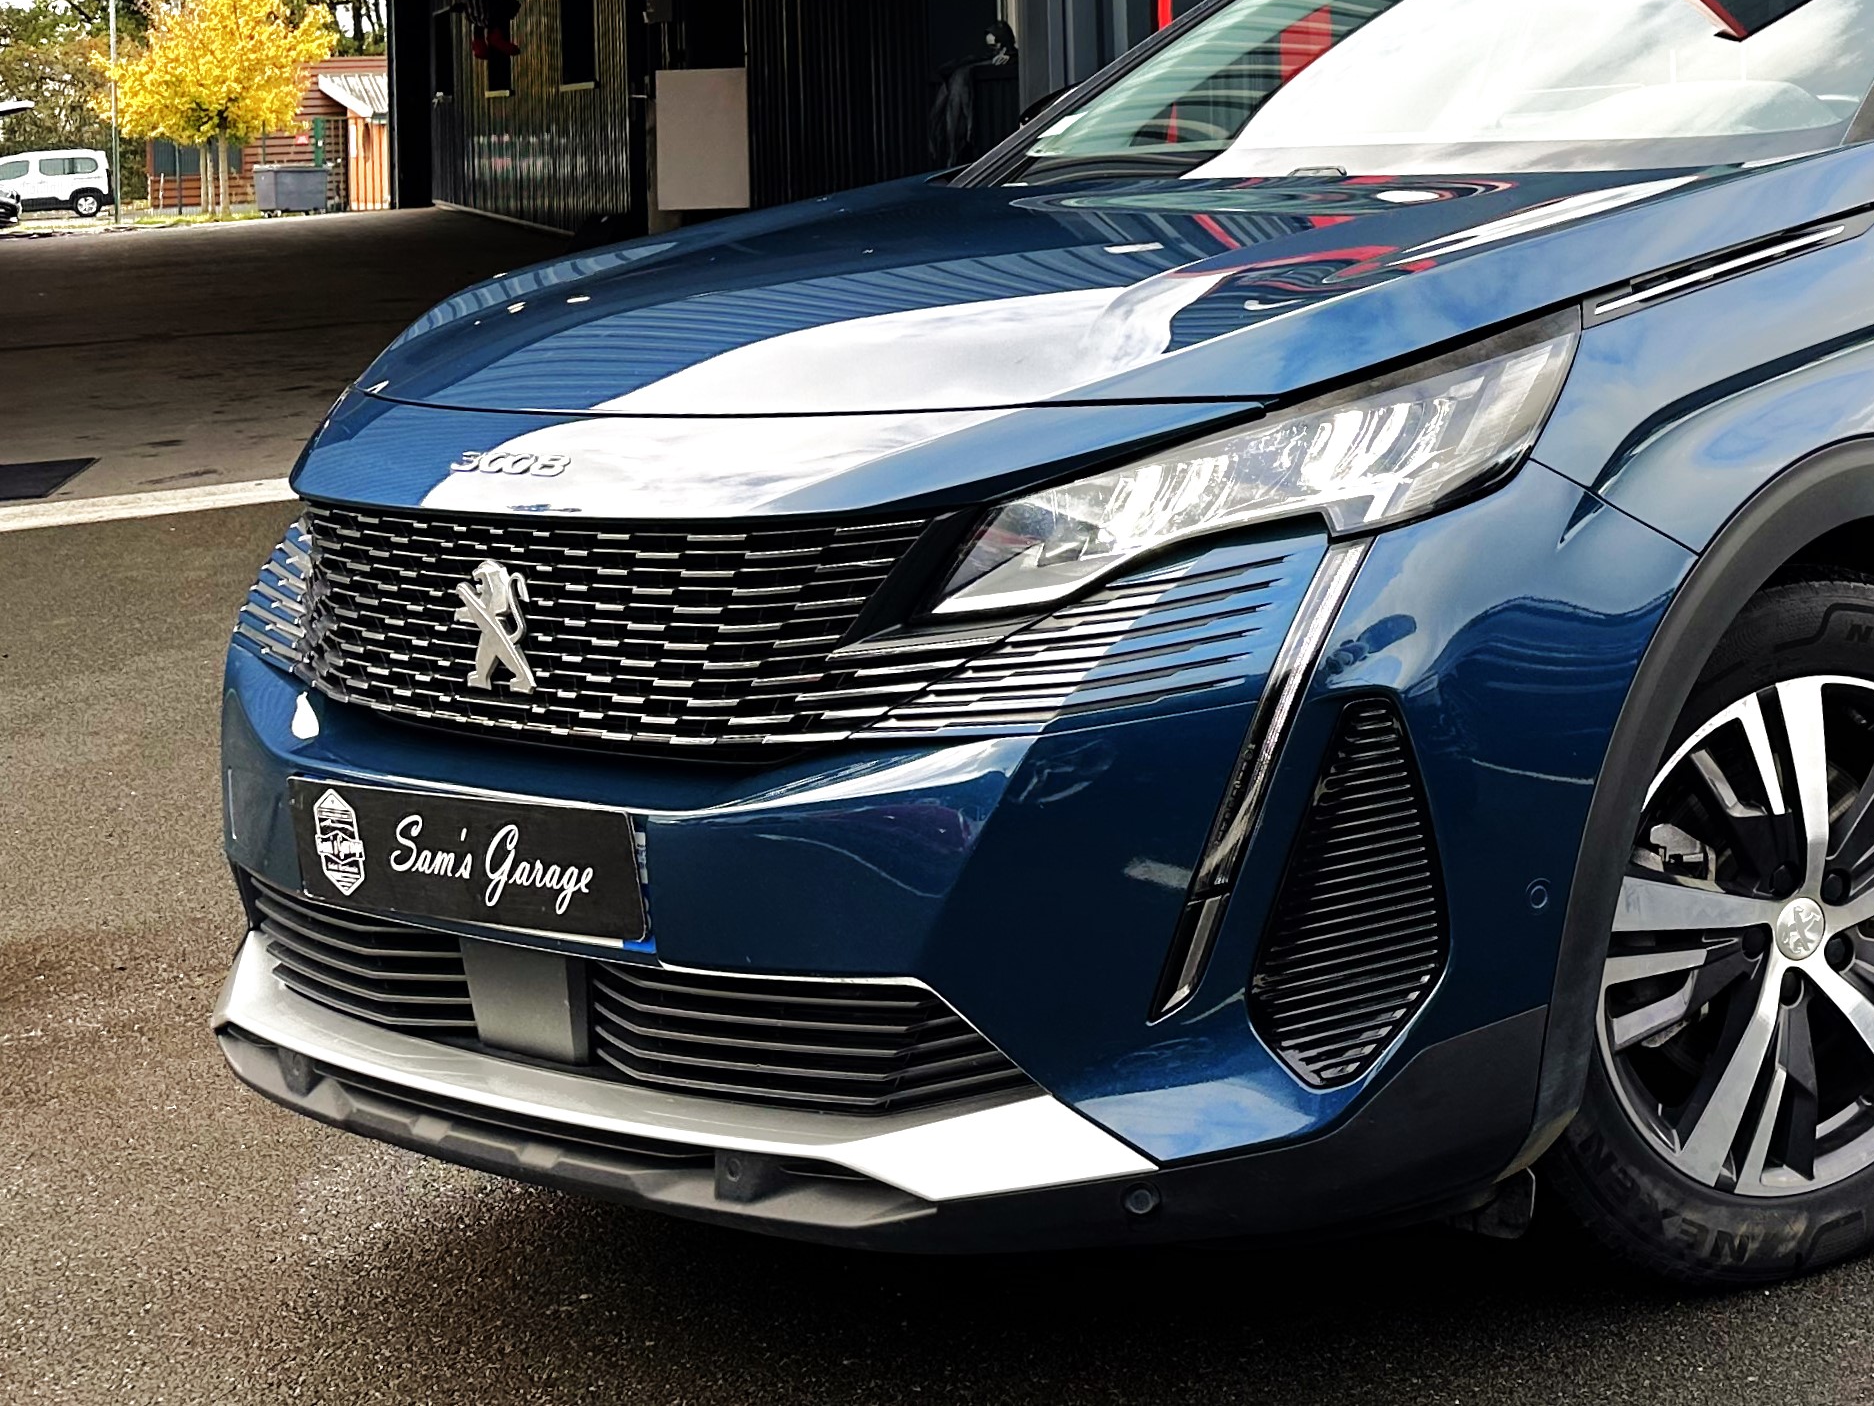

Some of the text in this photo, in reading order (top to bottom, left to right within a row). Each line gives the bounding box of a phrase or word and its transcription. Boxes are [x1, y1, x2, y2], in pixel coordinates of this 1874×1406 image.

[450, 450, 572, 478] 3008
[390, 814, 594, 915] Sam's Garage
